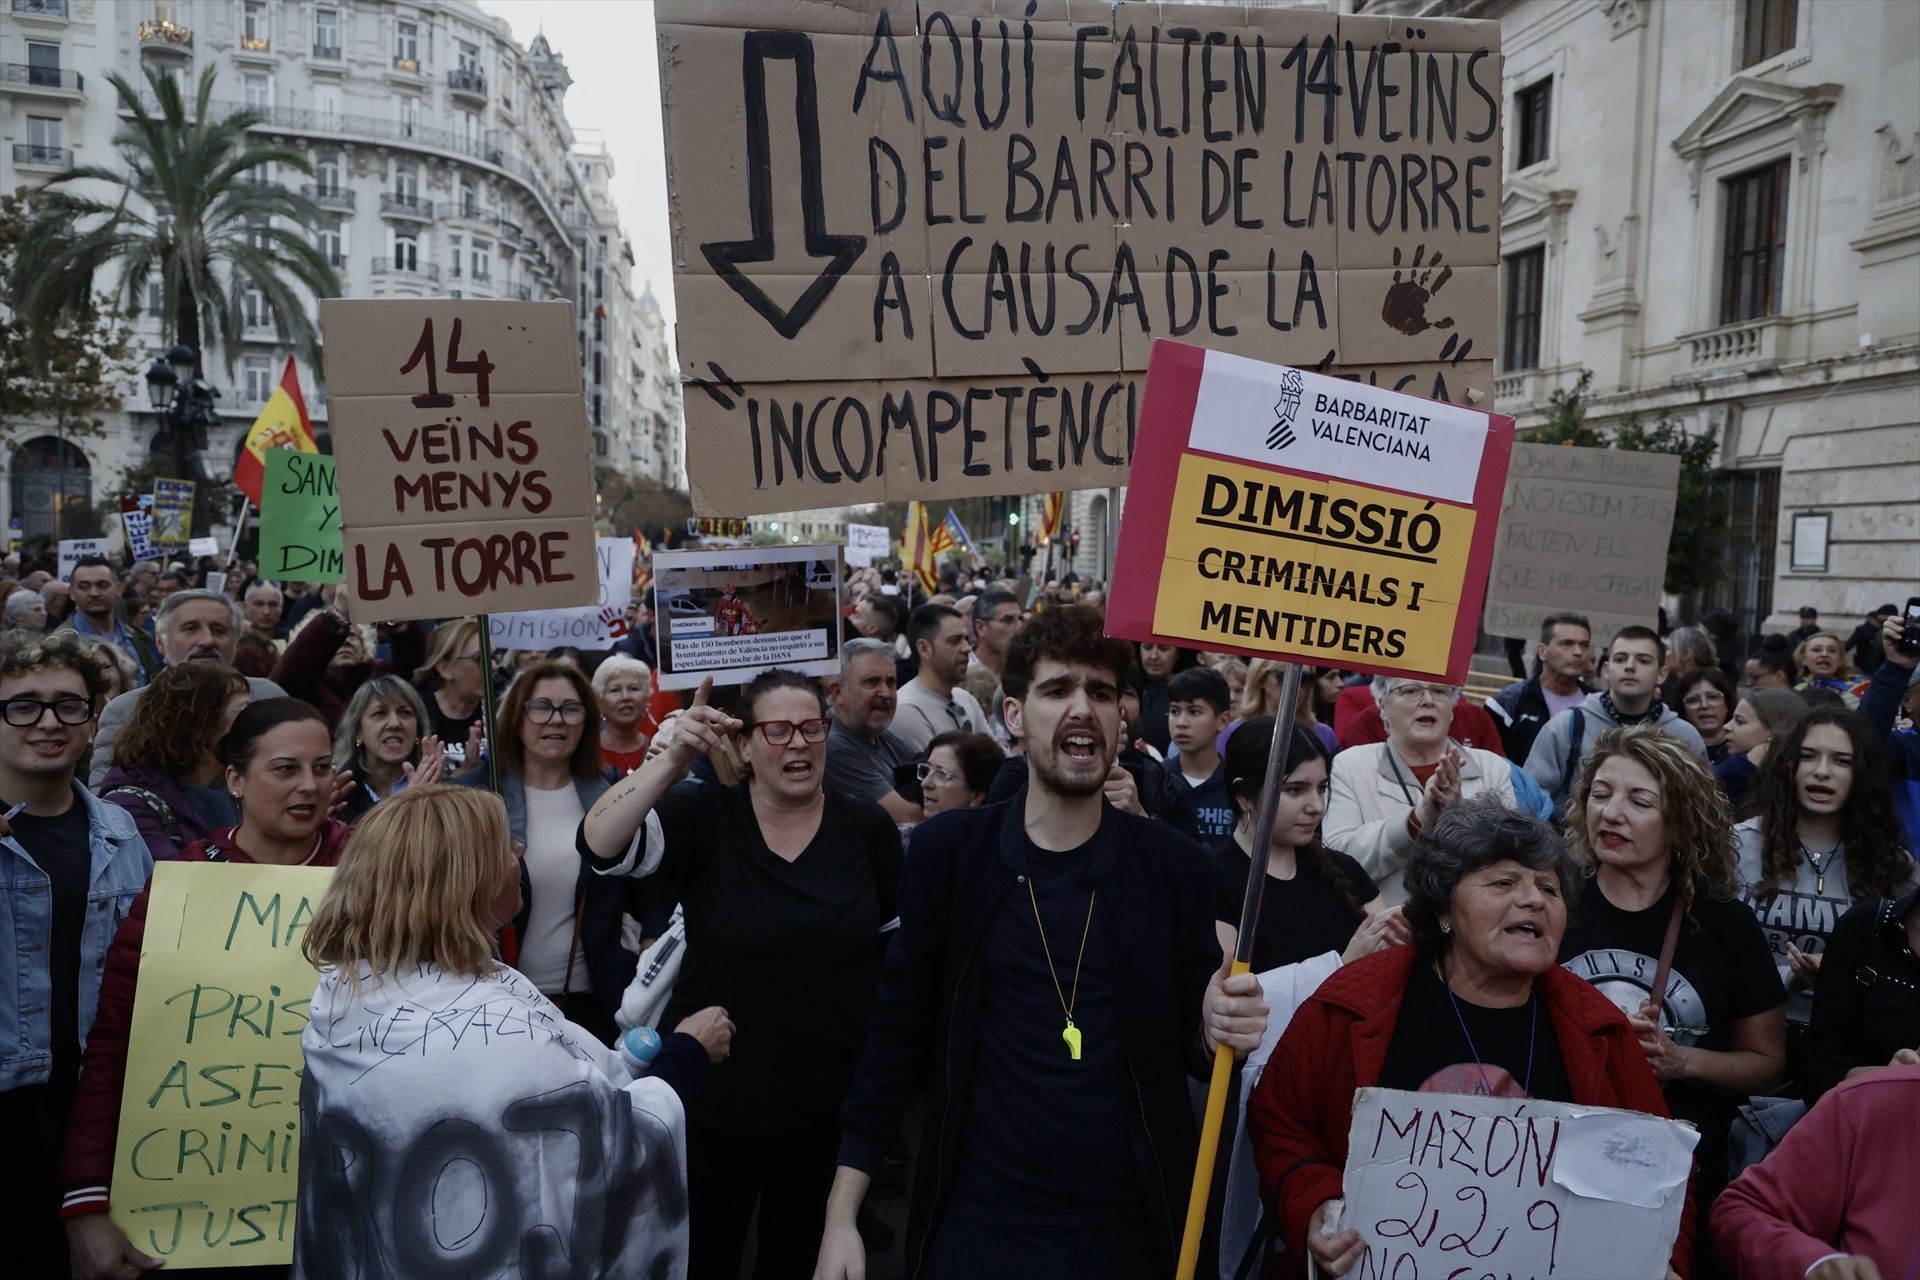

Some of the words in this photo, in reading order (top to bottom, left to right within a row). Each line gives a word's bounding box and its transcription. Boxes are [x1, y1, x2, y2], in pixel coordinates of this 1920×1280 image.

[853, 0, 1037, 129] AQUÍ
[1074, 24, 1267, 142] FALTEN
[1345, 26, 1498, 144] VEÏNS
[869, 135, 986, 235] DEL
[1006, 133, 1175, 224] BARRI
[1201, 148, 1266, 229] DE
[1283, 150, 1335, 229] LA
[1336, 152, 1491, 235] TORRE
[874, 250, 914, 342] A
[942, 236, 1151, 341] CAUSA
[1166, 246, 1239, 336] DE
[1267, 248, 1329, 332] LA
[400, 316, 496, 409] 14
[1315, 393, 1430, 434] BARBARITAT
[383, 415, 538, 464] VEÏNS
[1312, 418, 1430, 462] VALENCIANA
[281, 456, 339, 496] SAN
[395, 470, 552, 513] MENYS
[318, 505, 339, 531] Y
[1201, 473, 1441, 554] DIMISSIÓ
[1512, 484, 1555, 512] NO
[1560, 490, 1623, 518] ESTEM
[73, 542, 97, 550] PER
[1506, 523, 1589, 554] FALTEN
[1595, 537, 1632, 558] ELS
[356, 543, 414, 602] LA
[421, 531, 575, 595] TORRE
[1198, 547, 1398, 608] CRIMINALS
[1406, 581, 1424, 611] I
[1549, 569, 1593, 591] HEU
[490, 614, 602, 639] DIMISIÓN
[674, 642, 688, 650] Más
[690, 641, 700, 649] de
[701, 640, 713, 648] 150
[714, 637, 751, 647] bomberos
[752, 634, 789, 645] denuncian
[790, 634, 804, 643] que
[805, 632, 811, 640] el
[1201, 601, 1406, 657] MENTIDERS
[674, 648, 727, 660] Ayuntamiento
[728, 647, 737, 655] de
[779, 641, 807, 651] requirió
[674, 658, 721, 669] especialistas
[729, 655, 751, 664] noche
[752, 654, 762, 662] de
[770, 651, 791, 660] DANA
[147, 1060, 302, 1109] ASE
[1371, 1104, 1560, 1188] MAZÓN
